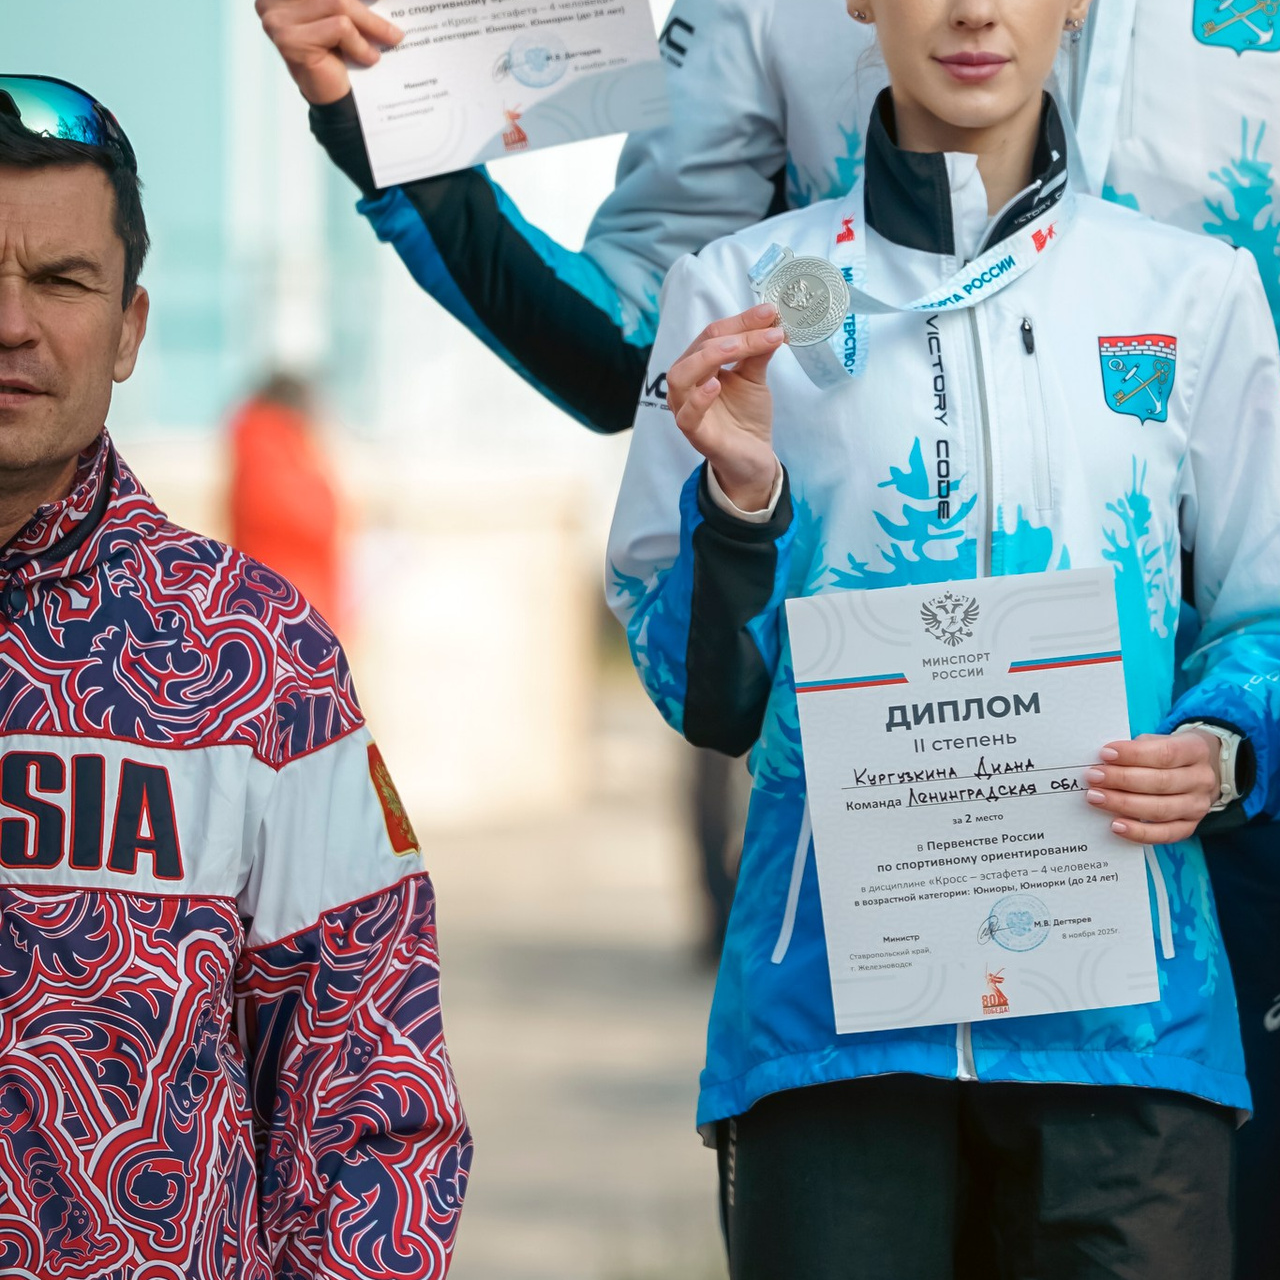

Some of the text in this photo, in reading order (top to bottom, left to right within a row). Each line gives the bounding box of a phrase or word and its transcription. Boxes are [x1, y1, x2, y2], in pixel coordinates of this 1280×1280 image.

[962, 255, 1016, 295] РОССИИ
[926, 314, 951, 520] VICTORY CODE
[921, 651, 991, 668] МИНСПОРТ
[931, 666, 984, 681] РОССИИ
[884, 691, 1041, 733] ДИПЛОМ
[913, 732, 1017, 753] II степень
[845, 798, 902, 811] Команда
[0, 750, 185, 881] SIA
[952, 817, 963, 825] за
[974, 813, 1004, 822] место
[926, 831, 1045, 852] Первенстве России
[876, 843, 1088, 873] по спортивному ориентированию
[867, 860, 1109, 893] дисциплине «Кросс эстафета человека»
[861, 871, 1119, 906] возрастной категории: Юниоры, Юниорки (до 24 лет)
[1052, 916, 1092, 927] Дегтярев
[882, 934, 920, 943] Министр
[848, 948, 910, 961] Ставропольский
